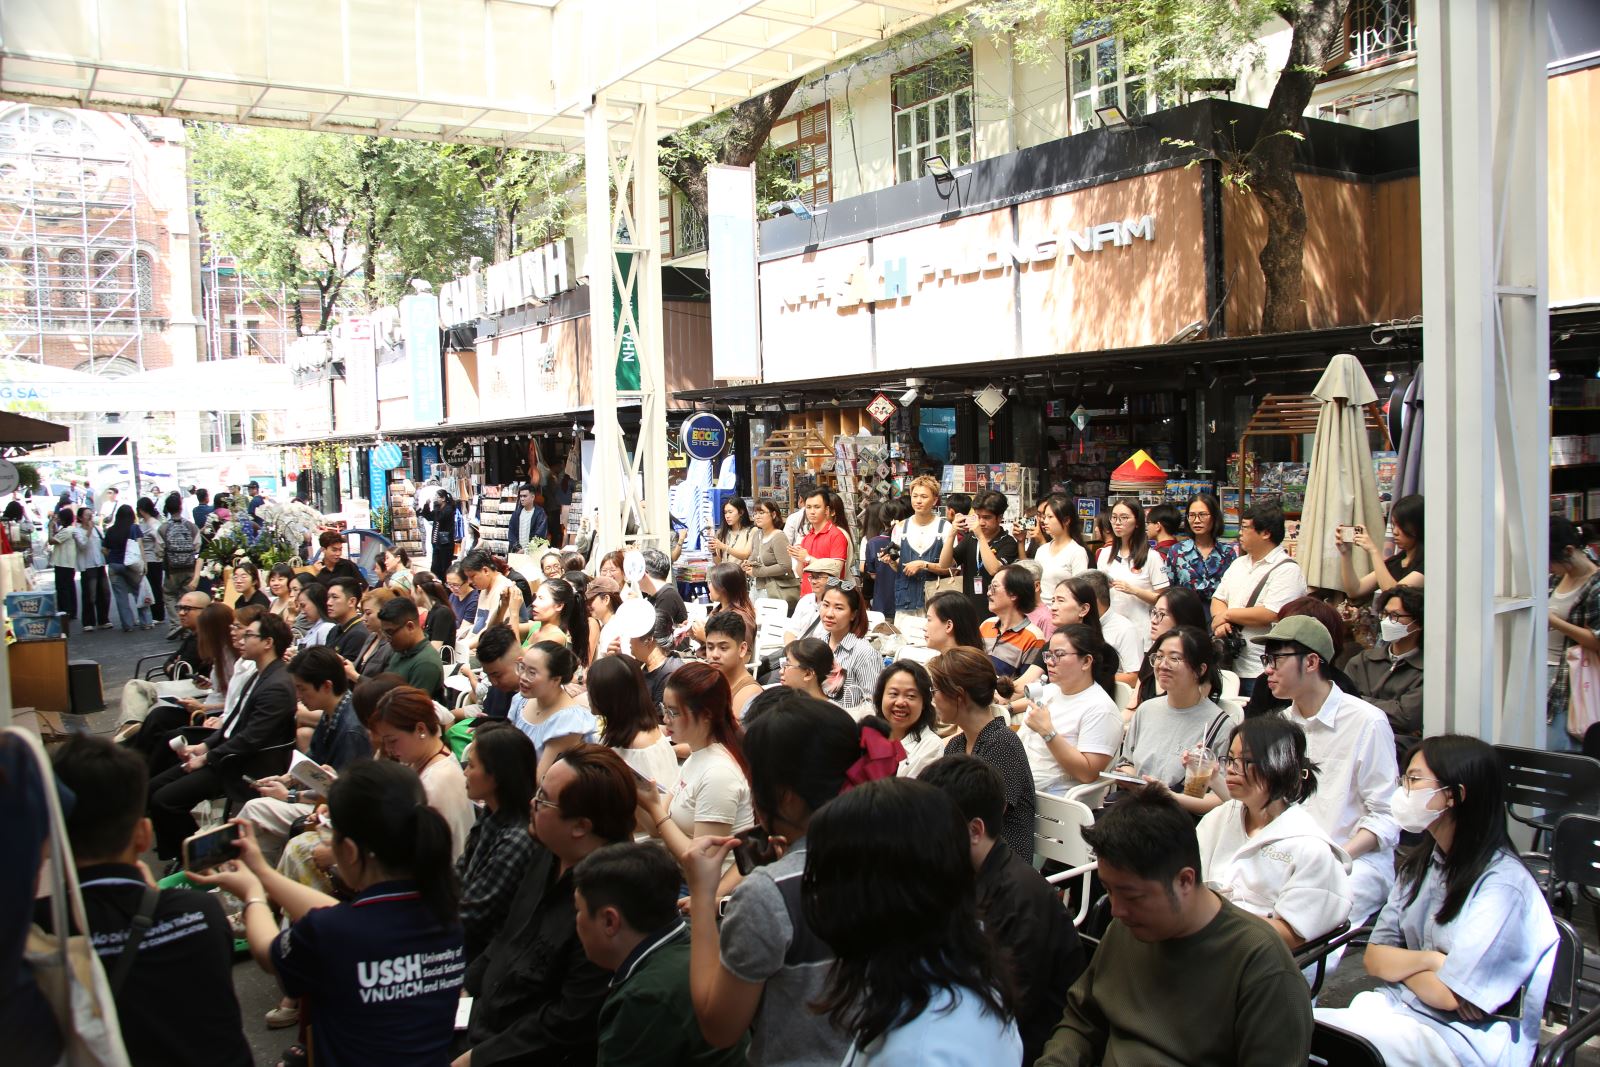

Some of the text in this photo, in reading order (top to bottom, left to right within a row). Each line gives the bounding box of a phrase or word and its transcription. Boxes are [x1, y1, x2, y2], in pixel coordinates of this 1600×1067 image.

[1065, 215, 1153, 254] NAM
[692, 431, 719, 441] BOOK
[421, 945, 463, 965] University of
[357, 952, 422, 988] USSH
[423, 965, 444, 978] Social
[359, 979, 424, 1003] VNUHCM
[423, 979, 439, 993] and
